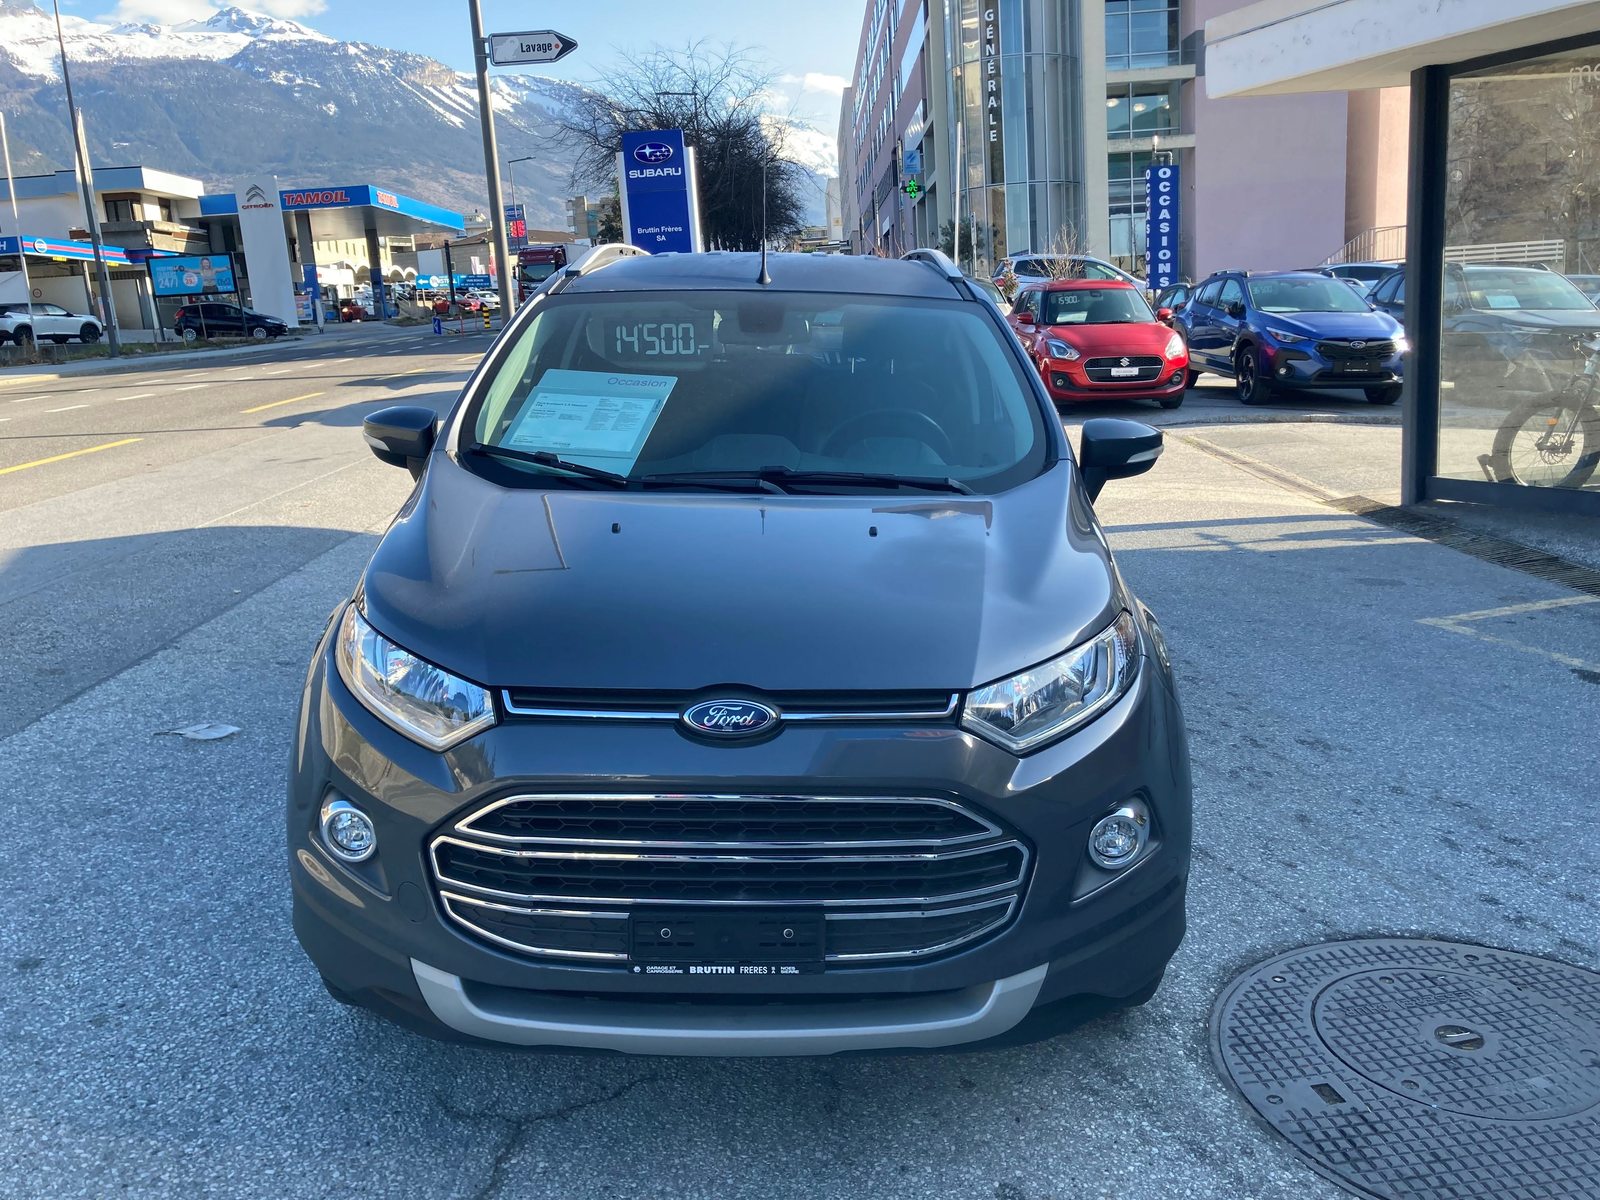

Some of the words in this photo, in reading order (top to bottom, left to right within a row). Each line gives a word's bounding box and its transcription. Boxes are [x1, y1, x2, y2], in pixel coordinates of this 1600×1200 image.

[520, 42, 553, 54] Lavage
[984, 9, 998, 142] GÉNÉRALE
[628, 167, 682, 179] SUBARU
[283, 190, 350, 206] TAMOIL
[1158, 167, 1172, 288] OCCASIONS
[607, 376, 668, 389] Occasion
[703, 705, 756, 727] Ford
[689, 965, 735, 974] BRUTTIN
